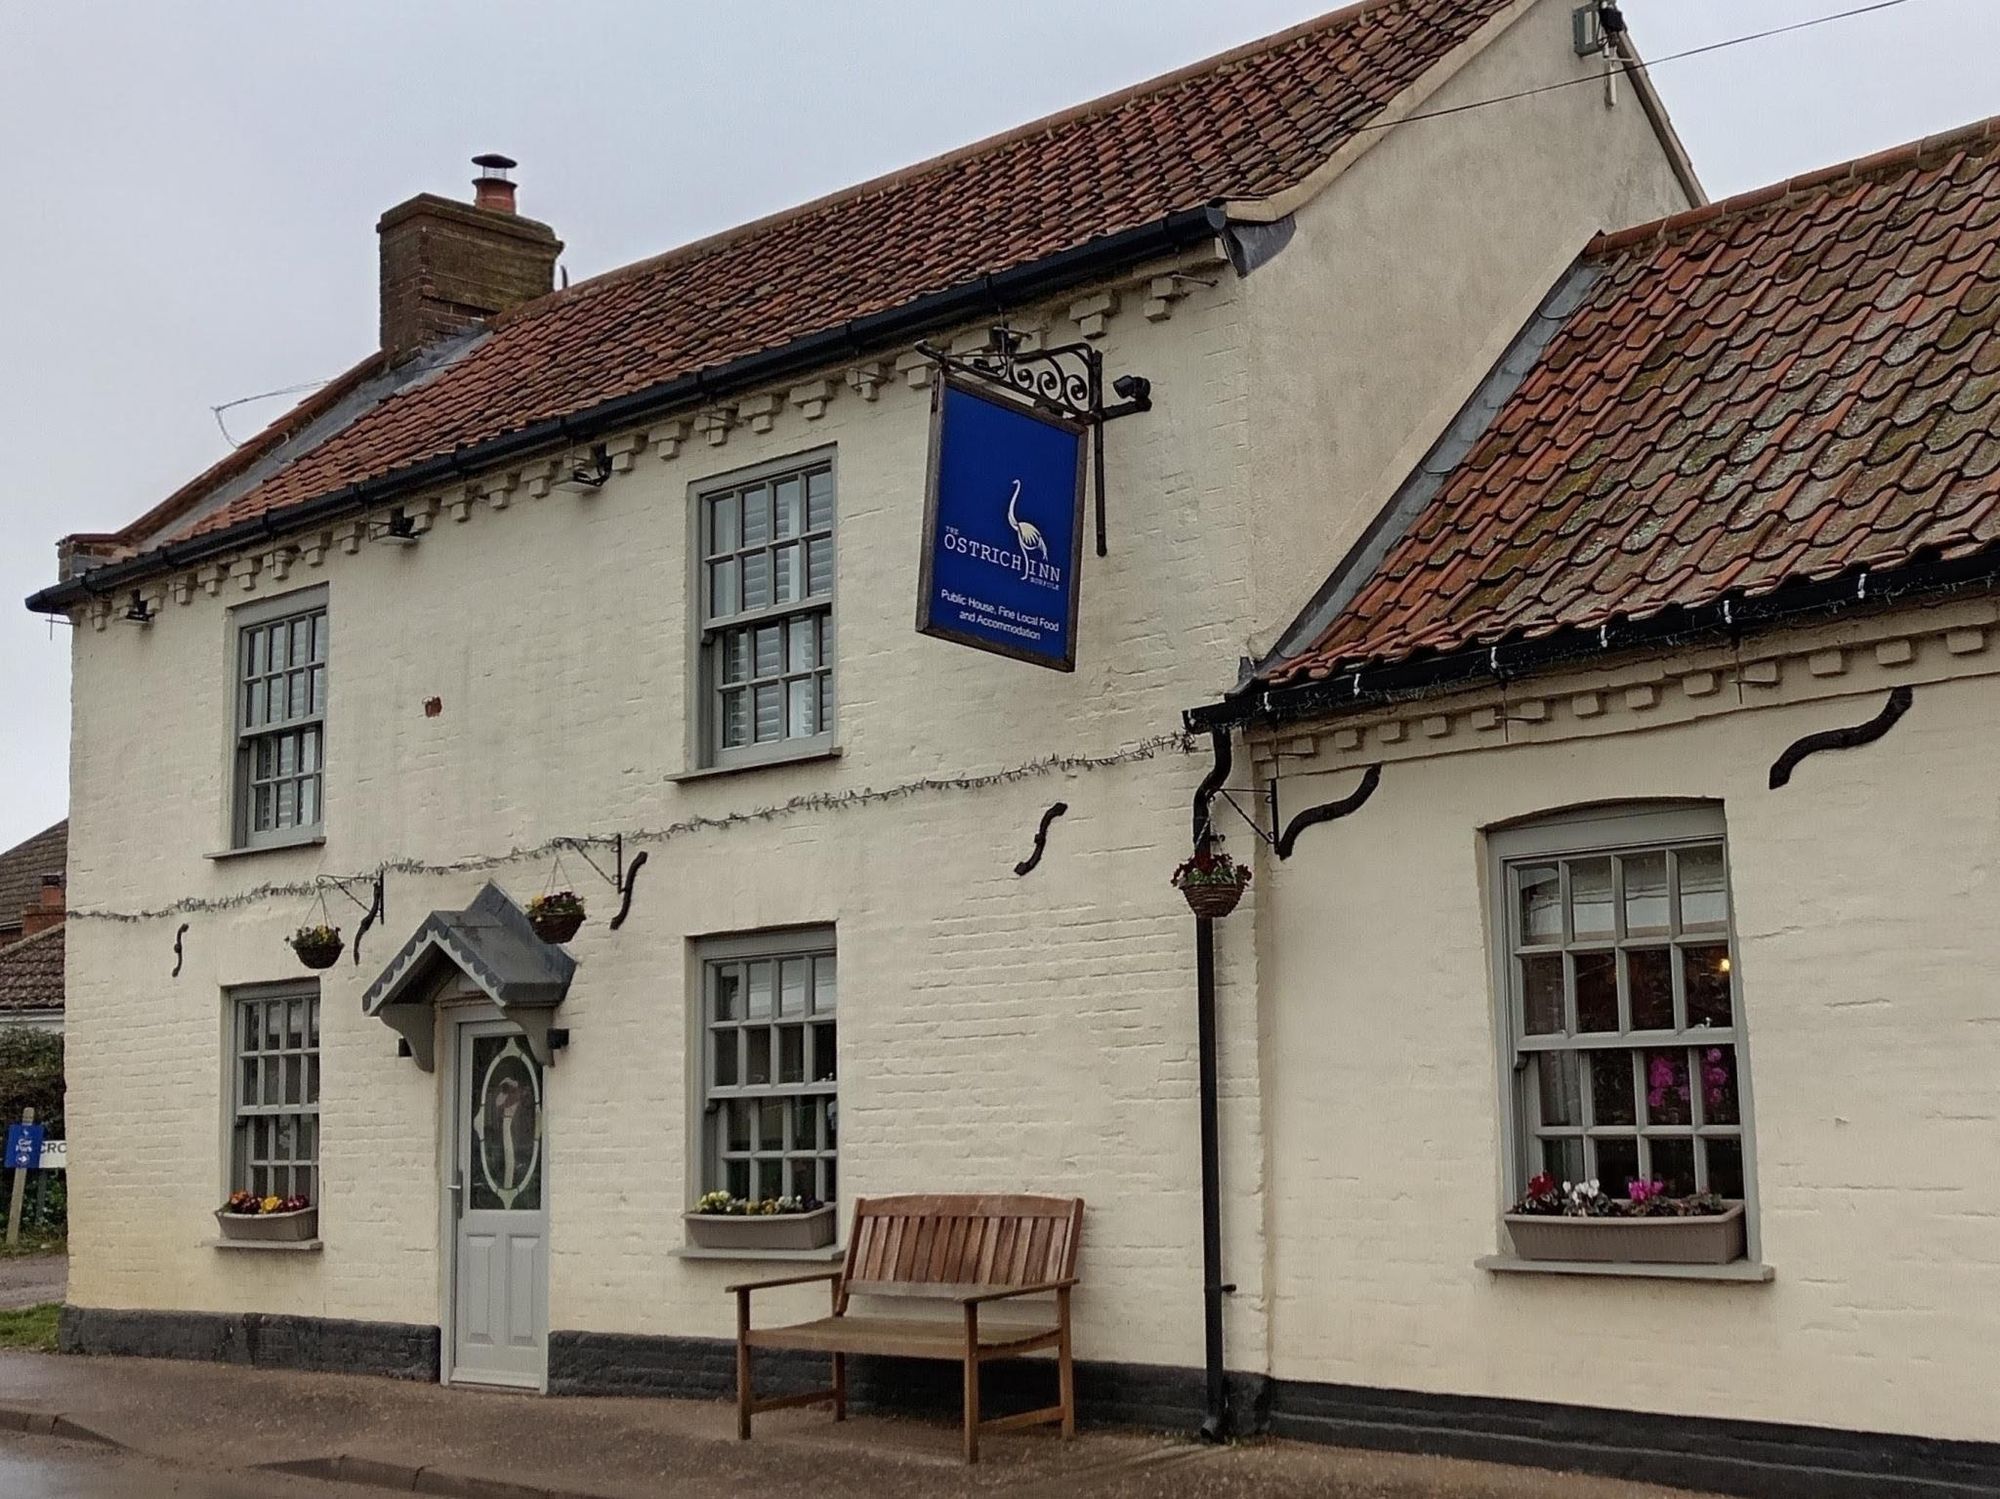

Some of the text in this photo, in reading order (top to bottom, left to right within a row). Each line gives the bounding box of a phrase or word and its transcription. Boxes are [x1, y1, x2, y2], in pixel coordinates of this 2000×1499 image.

[944, 534, 1060, 582] OSTRICH INN
[941, 589, 1059, 632] Public House, Fine Local Food
[959, 611, 1040, 639] and Accommodation
